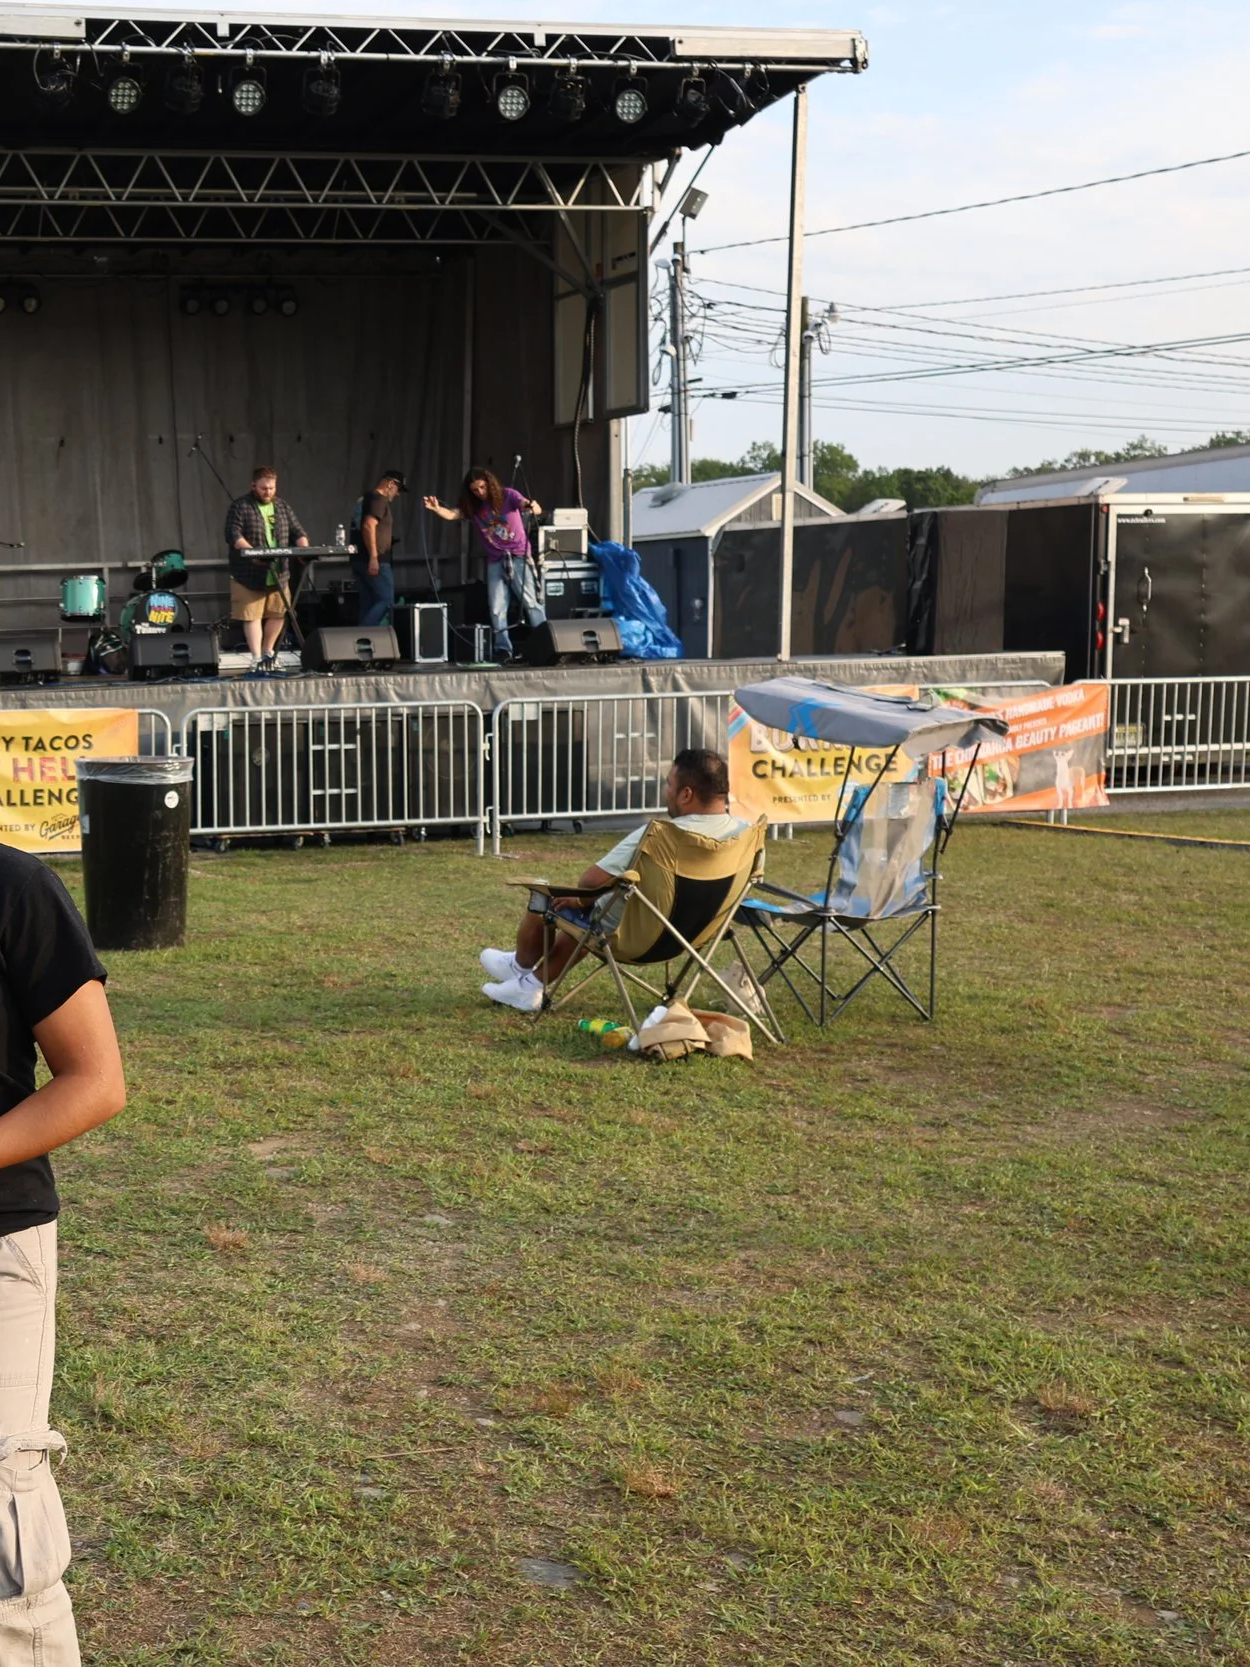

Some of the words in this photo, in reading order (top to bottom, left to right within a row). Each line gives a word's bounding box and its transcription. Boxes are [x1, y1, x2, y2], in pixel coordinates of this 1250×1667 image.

[148, 609, 175, 624] NITE
[1055, 688, 1085, 707] VODKA
[1015, 727, 1057, 749] BEAUTY
[1058, 711, 1105, 739] PAGEANT!
[21, 734, 94, 752] TACOS
[12, 756, 79, 784] HEL
[751, 753, 899, 779] CHALLENGE
[772, 795, 818, 804] PRESENTED
[821, 794, 831, 802] BY
[24, 823, 36, 832] BY
